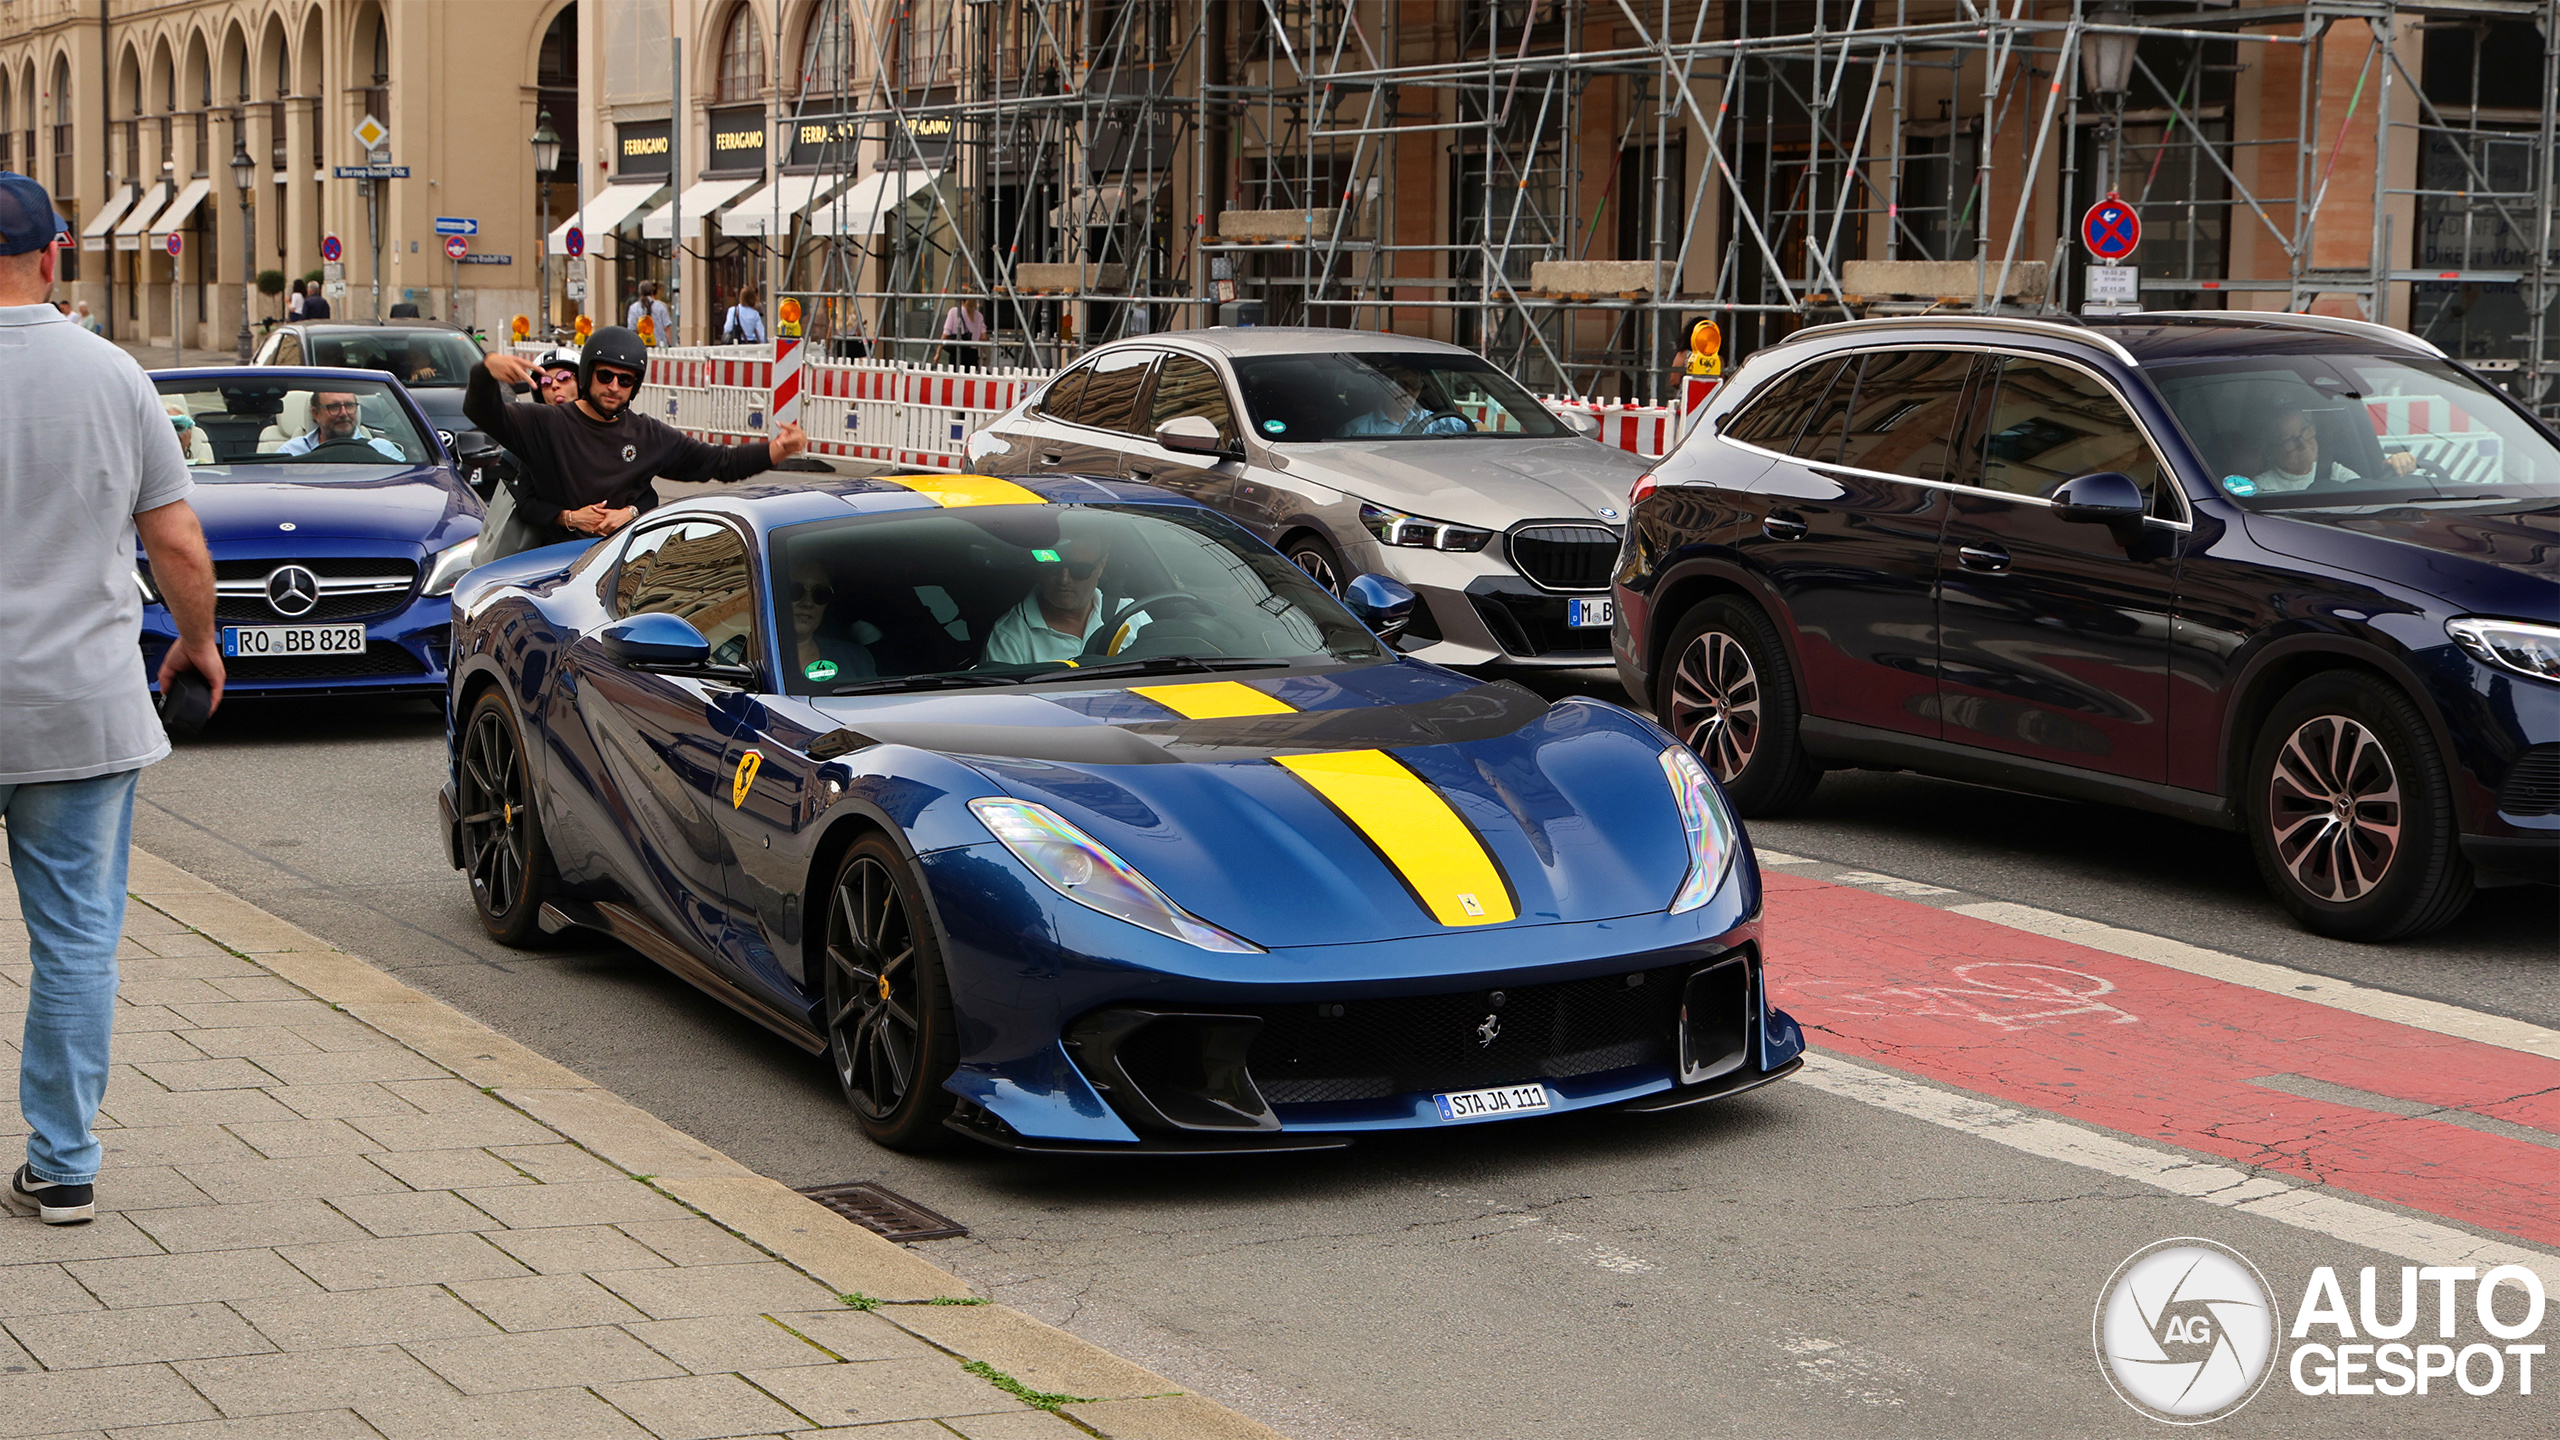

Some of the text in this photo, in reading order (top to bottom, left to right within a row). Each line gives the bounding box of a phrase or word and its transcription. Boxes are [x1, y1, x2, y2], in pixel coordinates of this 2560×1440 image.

[801, 123, 854, 144] FERRAMO
[895, 116, 951, 136] RAGAMO
[624, 136, 669, 155] FERRAGAMO
[716, 130, 764, 150] FERRAGAMO
[1056, 211, 1112, 226] ANRA
[2425, 246, 2483, 264] DIRET
[1581, 602, 1591, 622] M
[1603, 602, 1613, 622] B
[239, 630, 270, 653] RO
[285, 629, 316, 652] BB
[320, 628, 362, 651] 828
[816, 660, 826, 671] 4
[1452, 1094, 1487, 1115] STA
[1487, 1091, 1511, 1111] JA
[1512, 1087, 1546, 1108] 111
